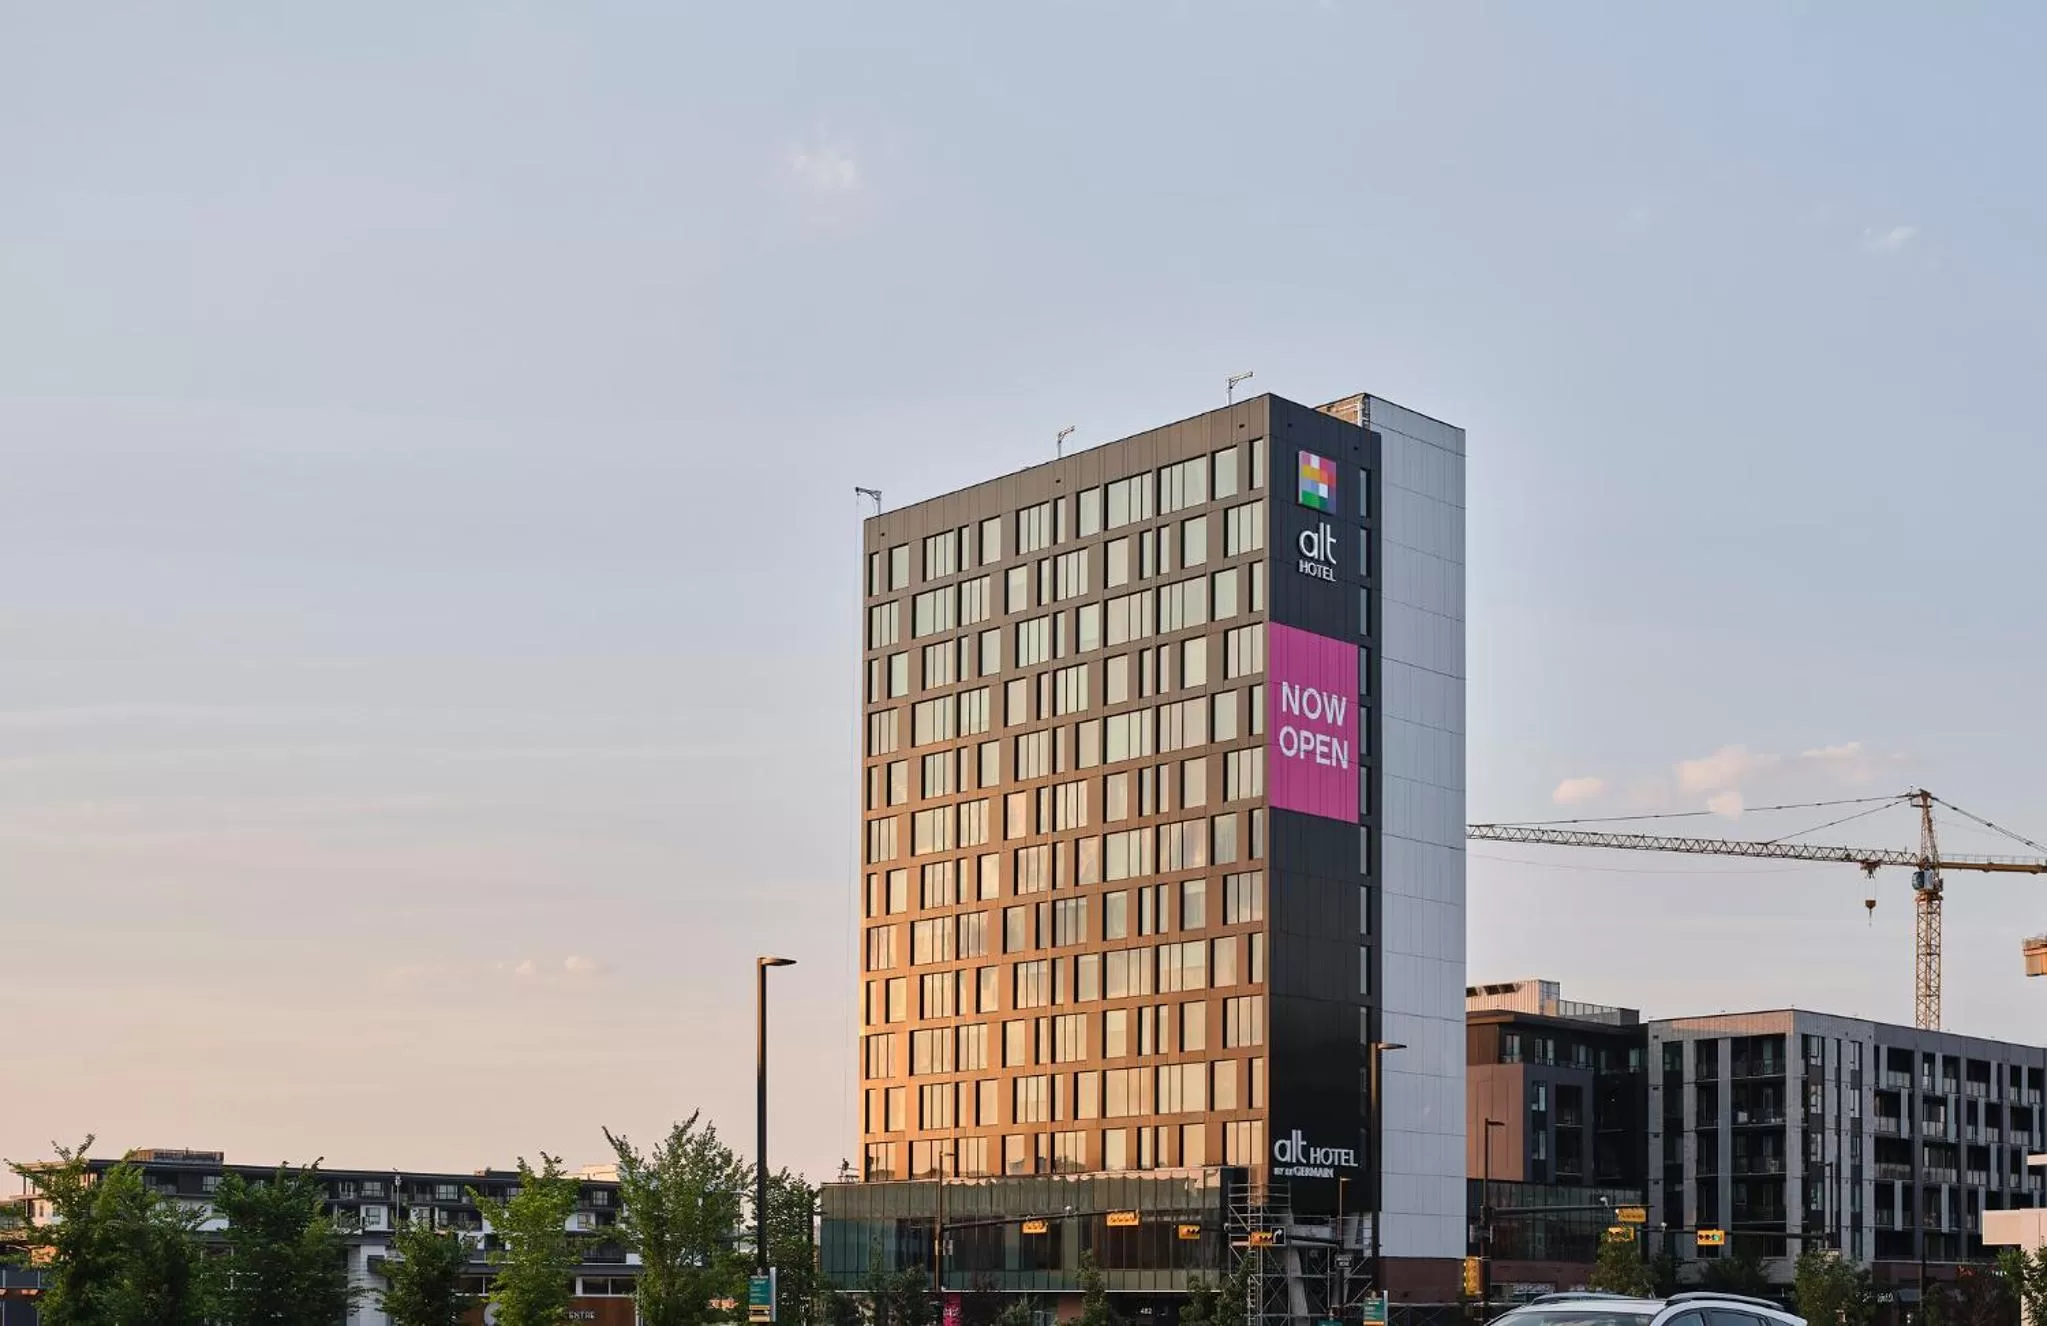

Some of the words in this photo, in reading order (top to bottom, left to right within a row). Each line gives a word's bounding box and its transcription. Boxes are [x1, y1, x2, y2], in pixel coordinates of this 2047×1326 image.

[1299, 521, 1337, 565] alt
[1299, 559, 1337, 582] HOTEL
[1282, 681, 1347, 727] NOW
[1279, 725, 1348, 769] OPEN
[1274, 1129, 1307, 1164] alt
[1309, 1146, 1359, 1167] HOTEL
[567, 1310, 596, 1320] ENTRE
